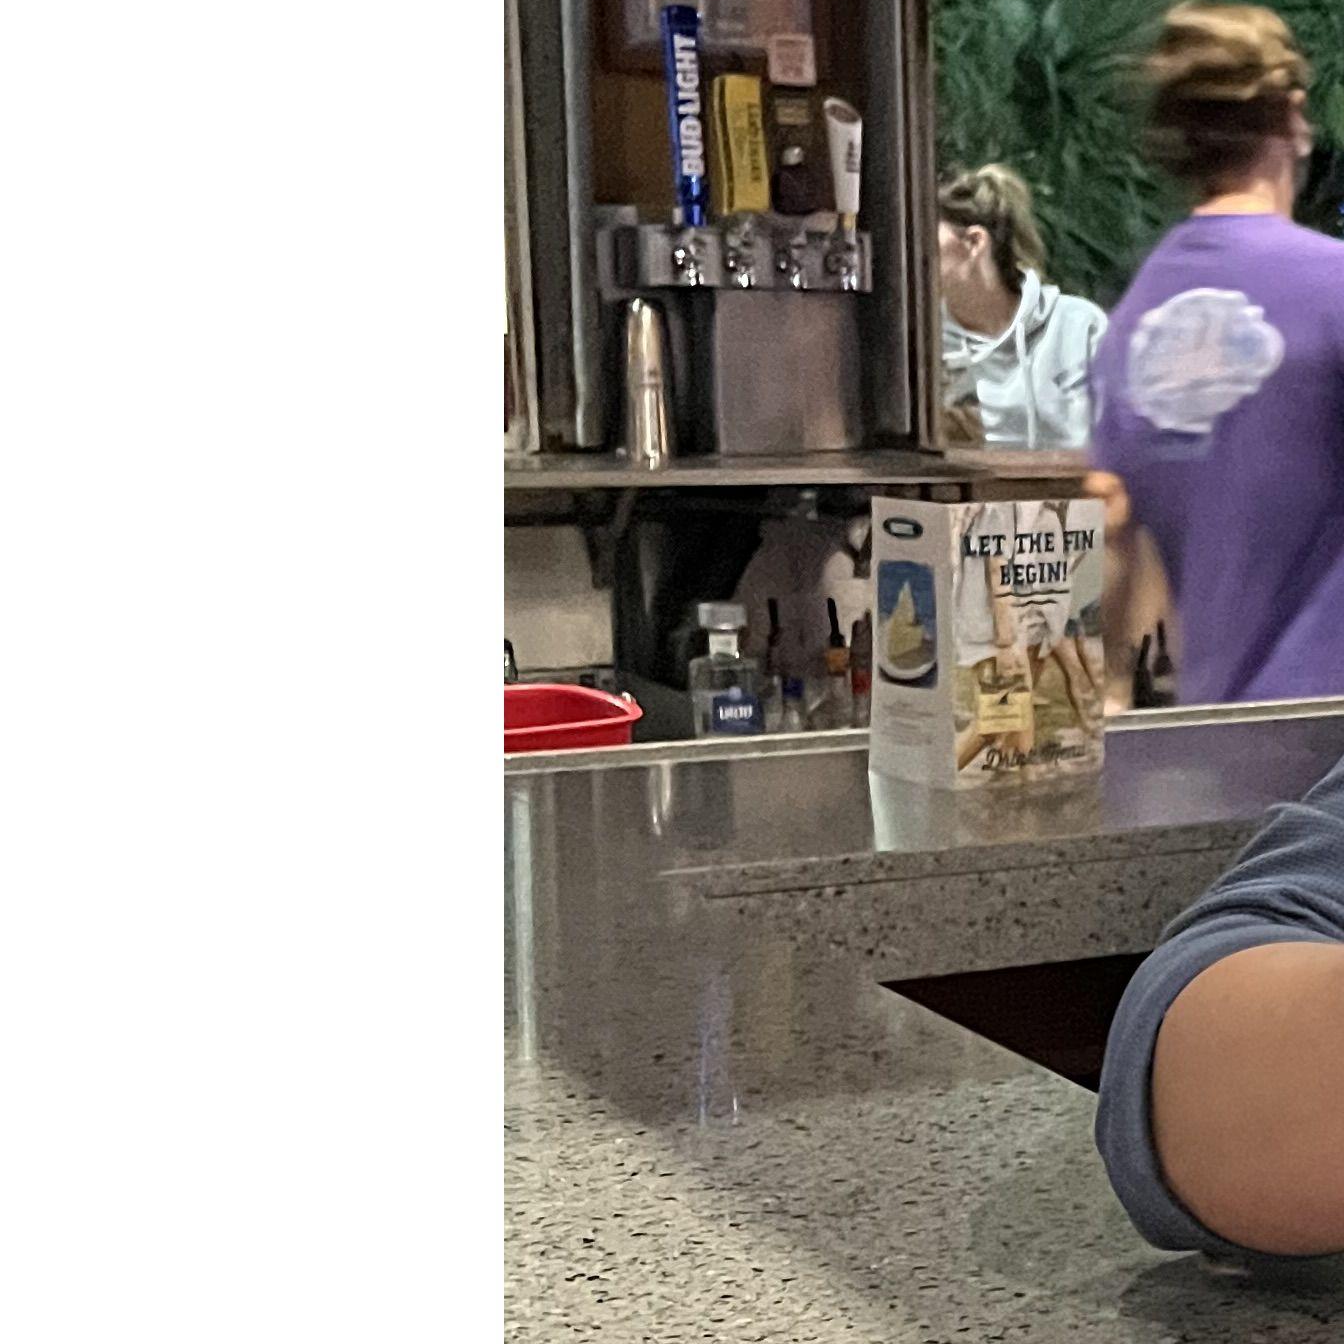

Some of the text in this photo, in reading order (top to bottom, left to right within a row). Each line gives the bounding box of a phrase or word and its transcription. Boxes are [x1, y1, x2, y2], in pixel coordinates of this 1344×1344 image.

[672, 33, 706, 177] BUD LIGHT
[962, 529, 1096, 556] LET THE FIN
[1000, 560, 1068, 586] BEGIN!
